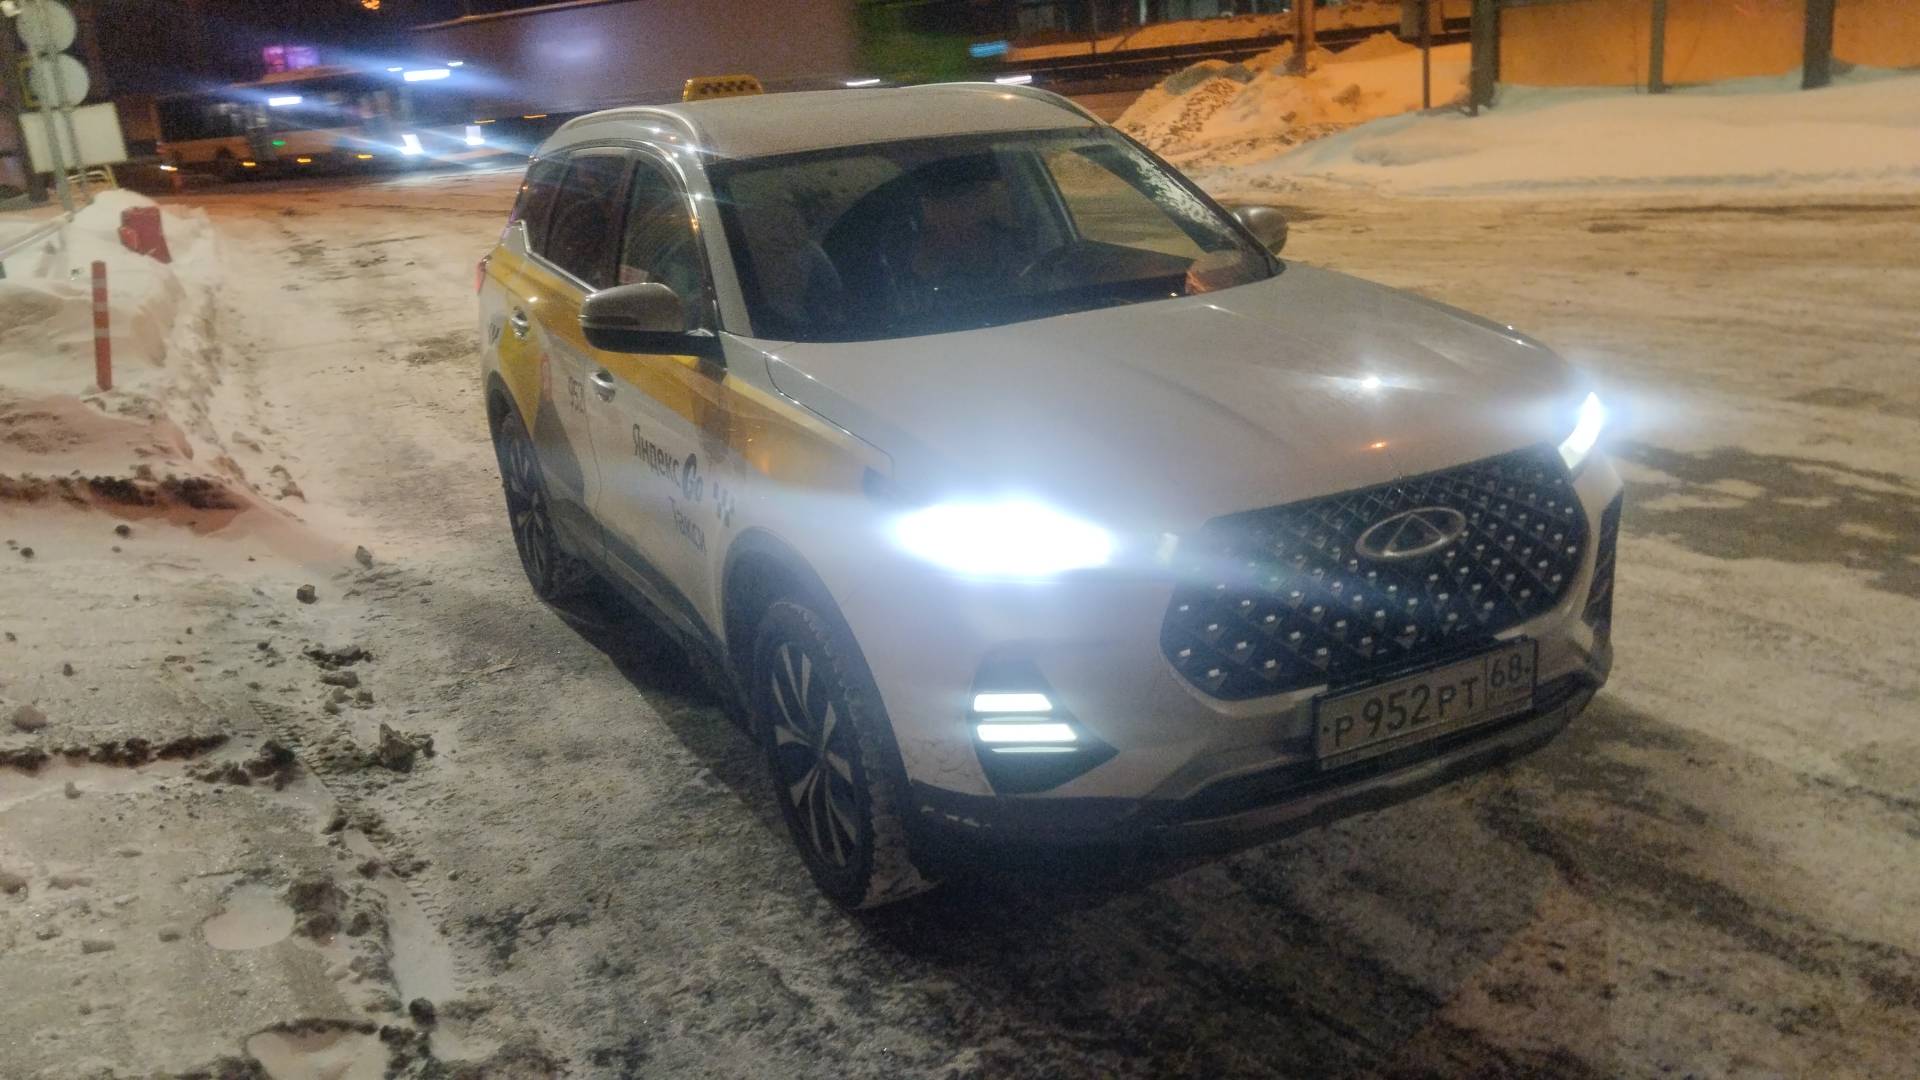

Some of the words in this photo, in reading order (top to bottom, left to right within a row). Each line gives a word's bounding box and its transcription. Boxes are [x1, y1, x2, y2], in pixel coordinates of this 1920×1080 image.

[631, 422, 682, 489] Яндекс
[682, 452, 704, 502] Go
[1489, 652, 1523, 690] 68
